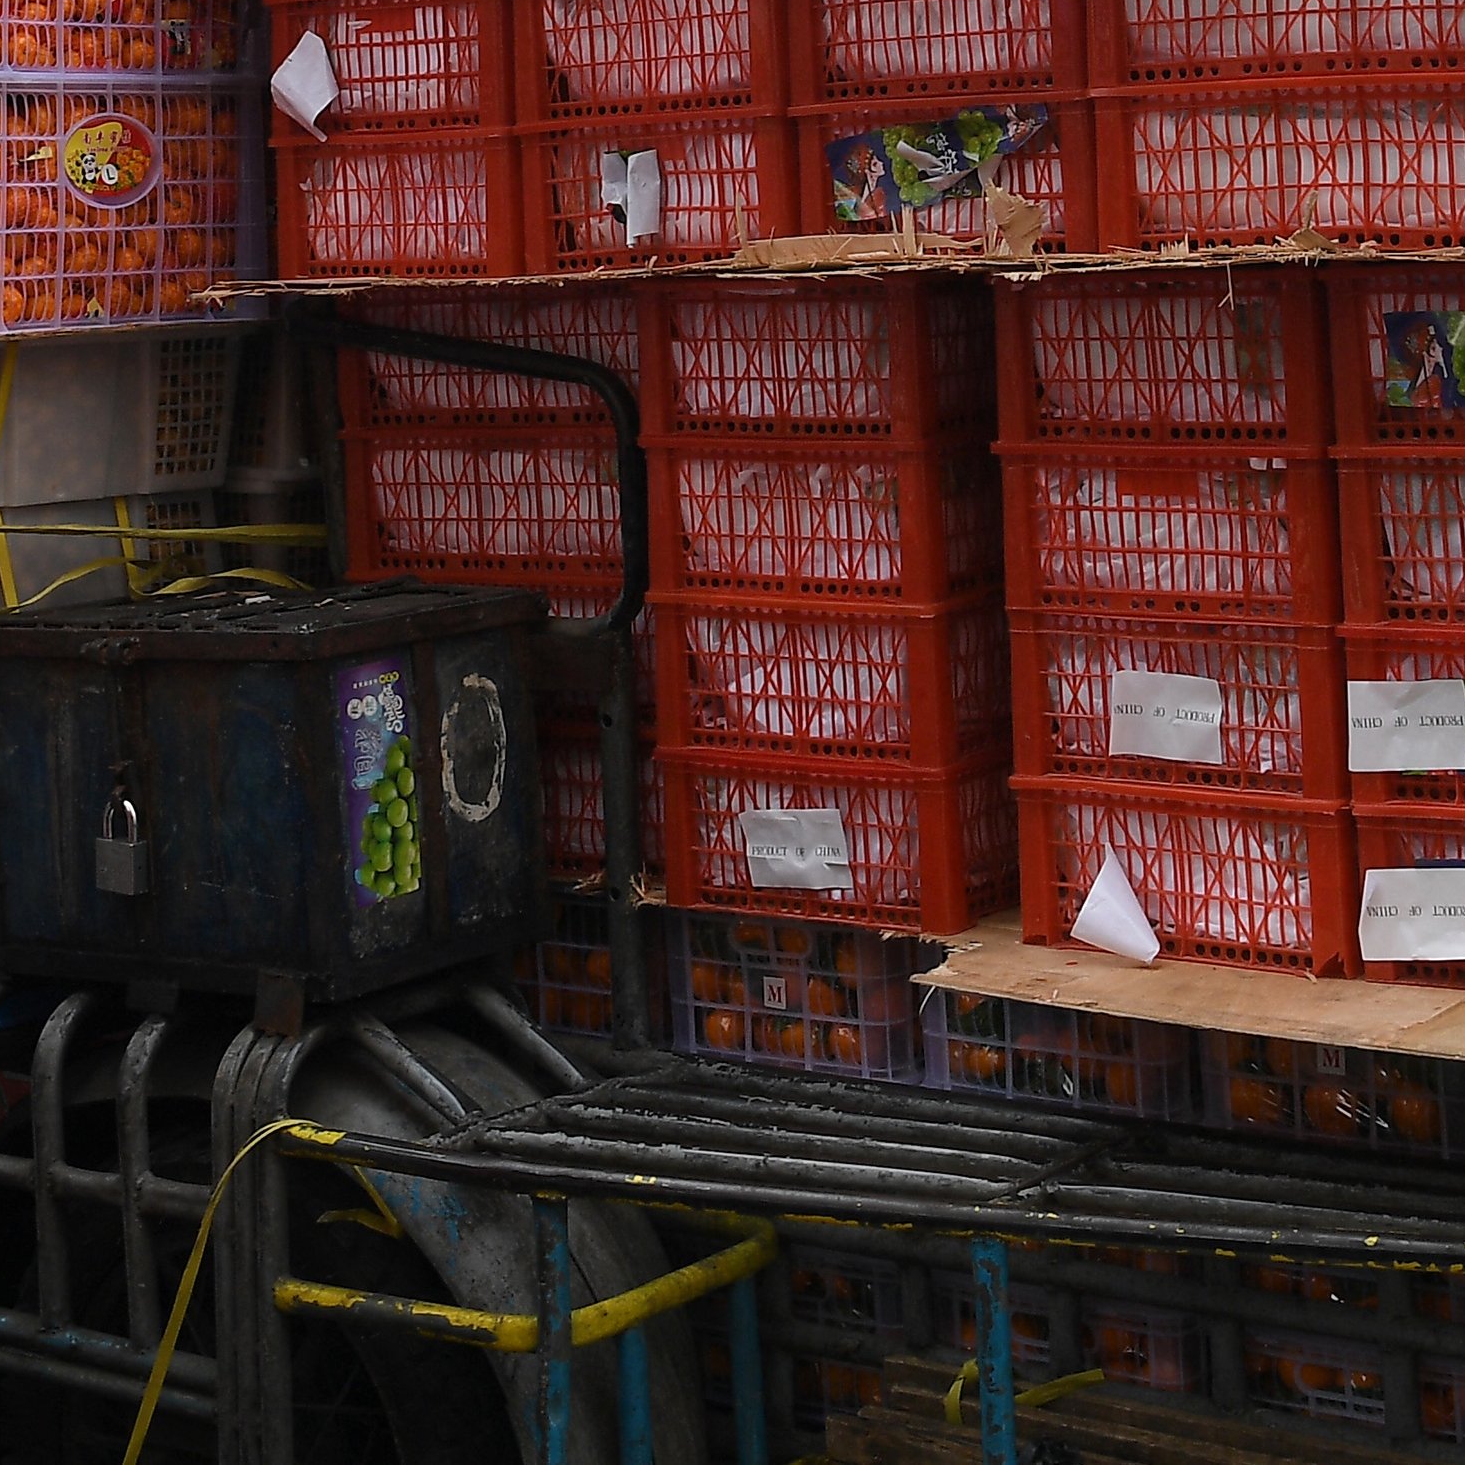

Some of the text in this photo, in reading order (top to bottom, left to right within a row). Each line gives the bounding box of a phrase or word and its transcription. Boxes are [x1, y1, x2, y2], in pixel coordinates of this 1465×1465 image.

[106, 168, 115, 180] L
[1114, 704, 1143, 715] CHIN
[1176, 708, 1215, 723] PRODUCT
[1352, 715, 1464, 728] PRODUCT OF CHINA
[1367, 905, 1398, 917] CHINA
[1409, 906, 1421, 916] OF
[766, 982, 785, 1004] M
[1323, 1049, 1341, 1069] M
